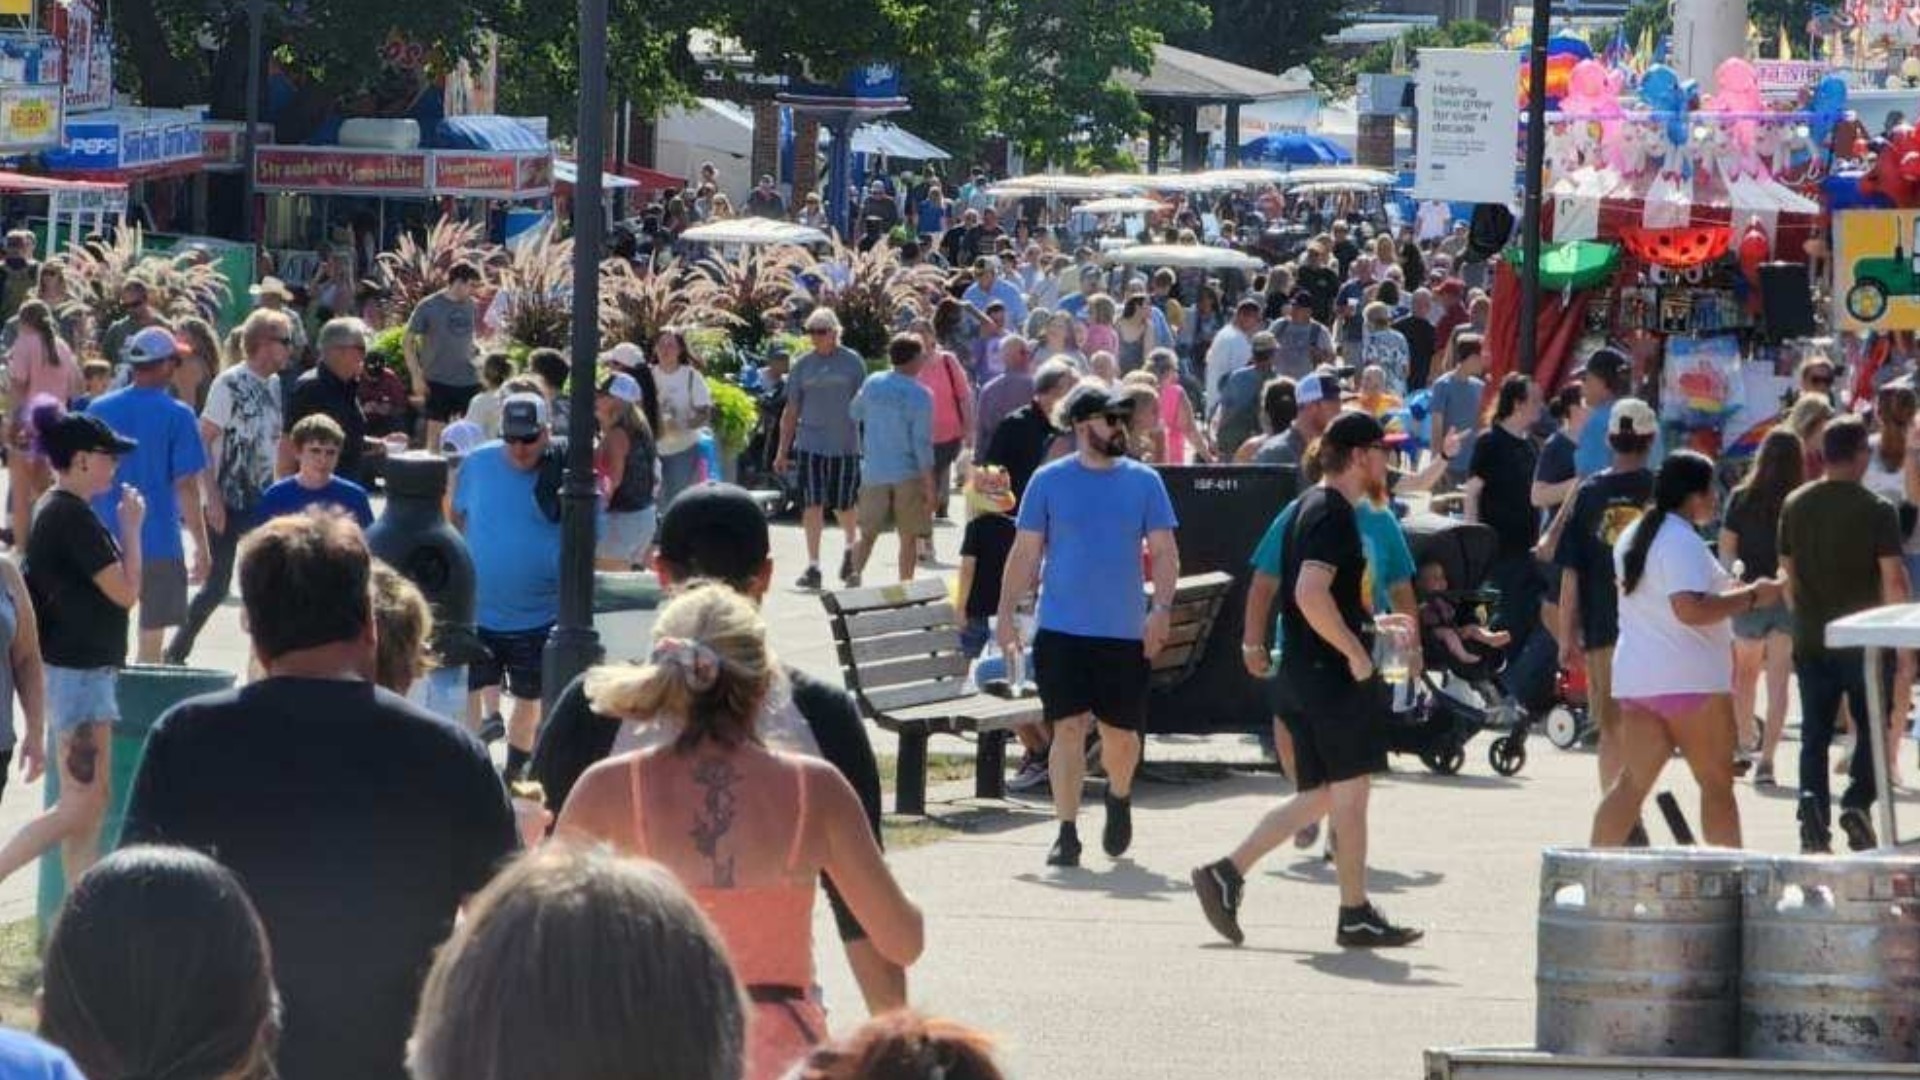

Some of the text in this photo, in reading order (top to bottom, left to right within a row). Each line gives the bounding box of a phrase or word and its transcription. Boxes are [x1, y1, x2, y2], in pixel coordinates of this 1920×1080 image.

[1433, 83, 1478, 98] Helping
[1462, 100, 1493, 111] grow
[1432, 110, 1450, 120] for
[1453, 112, 1479, 121] over
[1432, 122, 1475, 134] decade
[259, 155, 422, 181] Strawberry Smoothies
[1193, 478, 1239, 490] ISF-011
